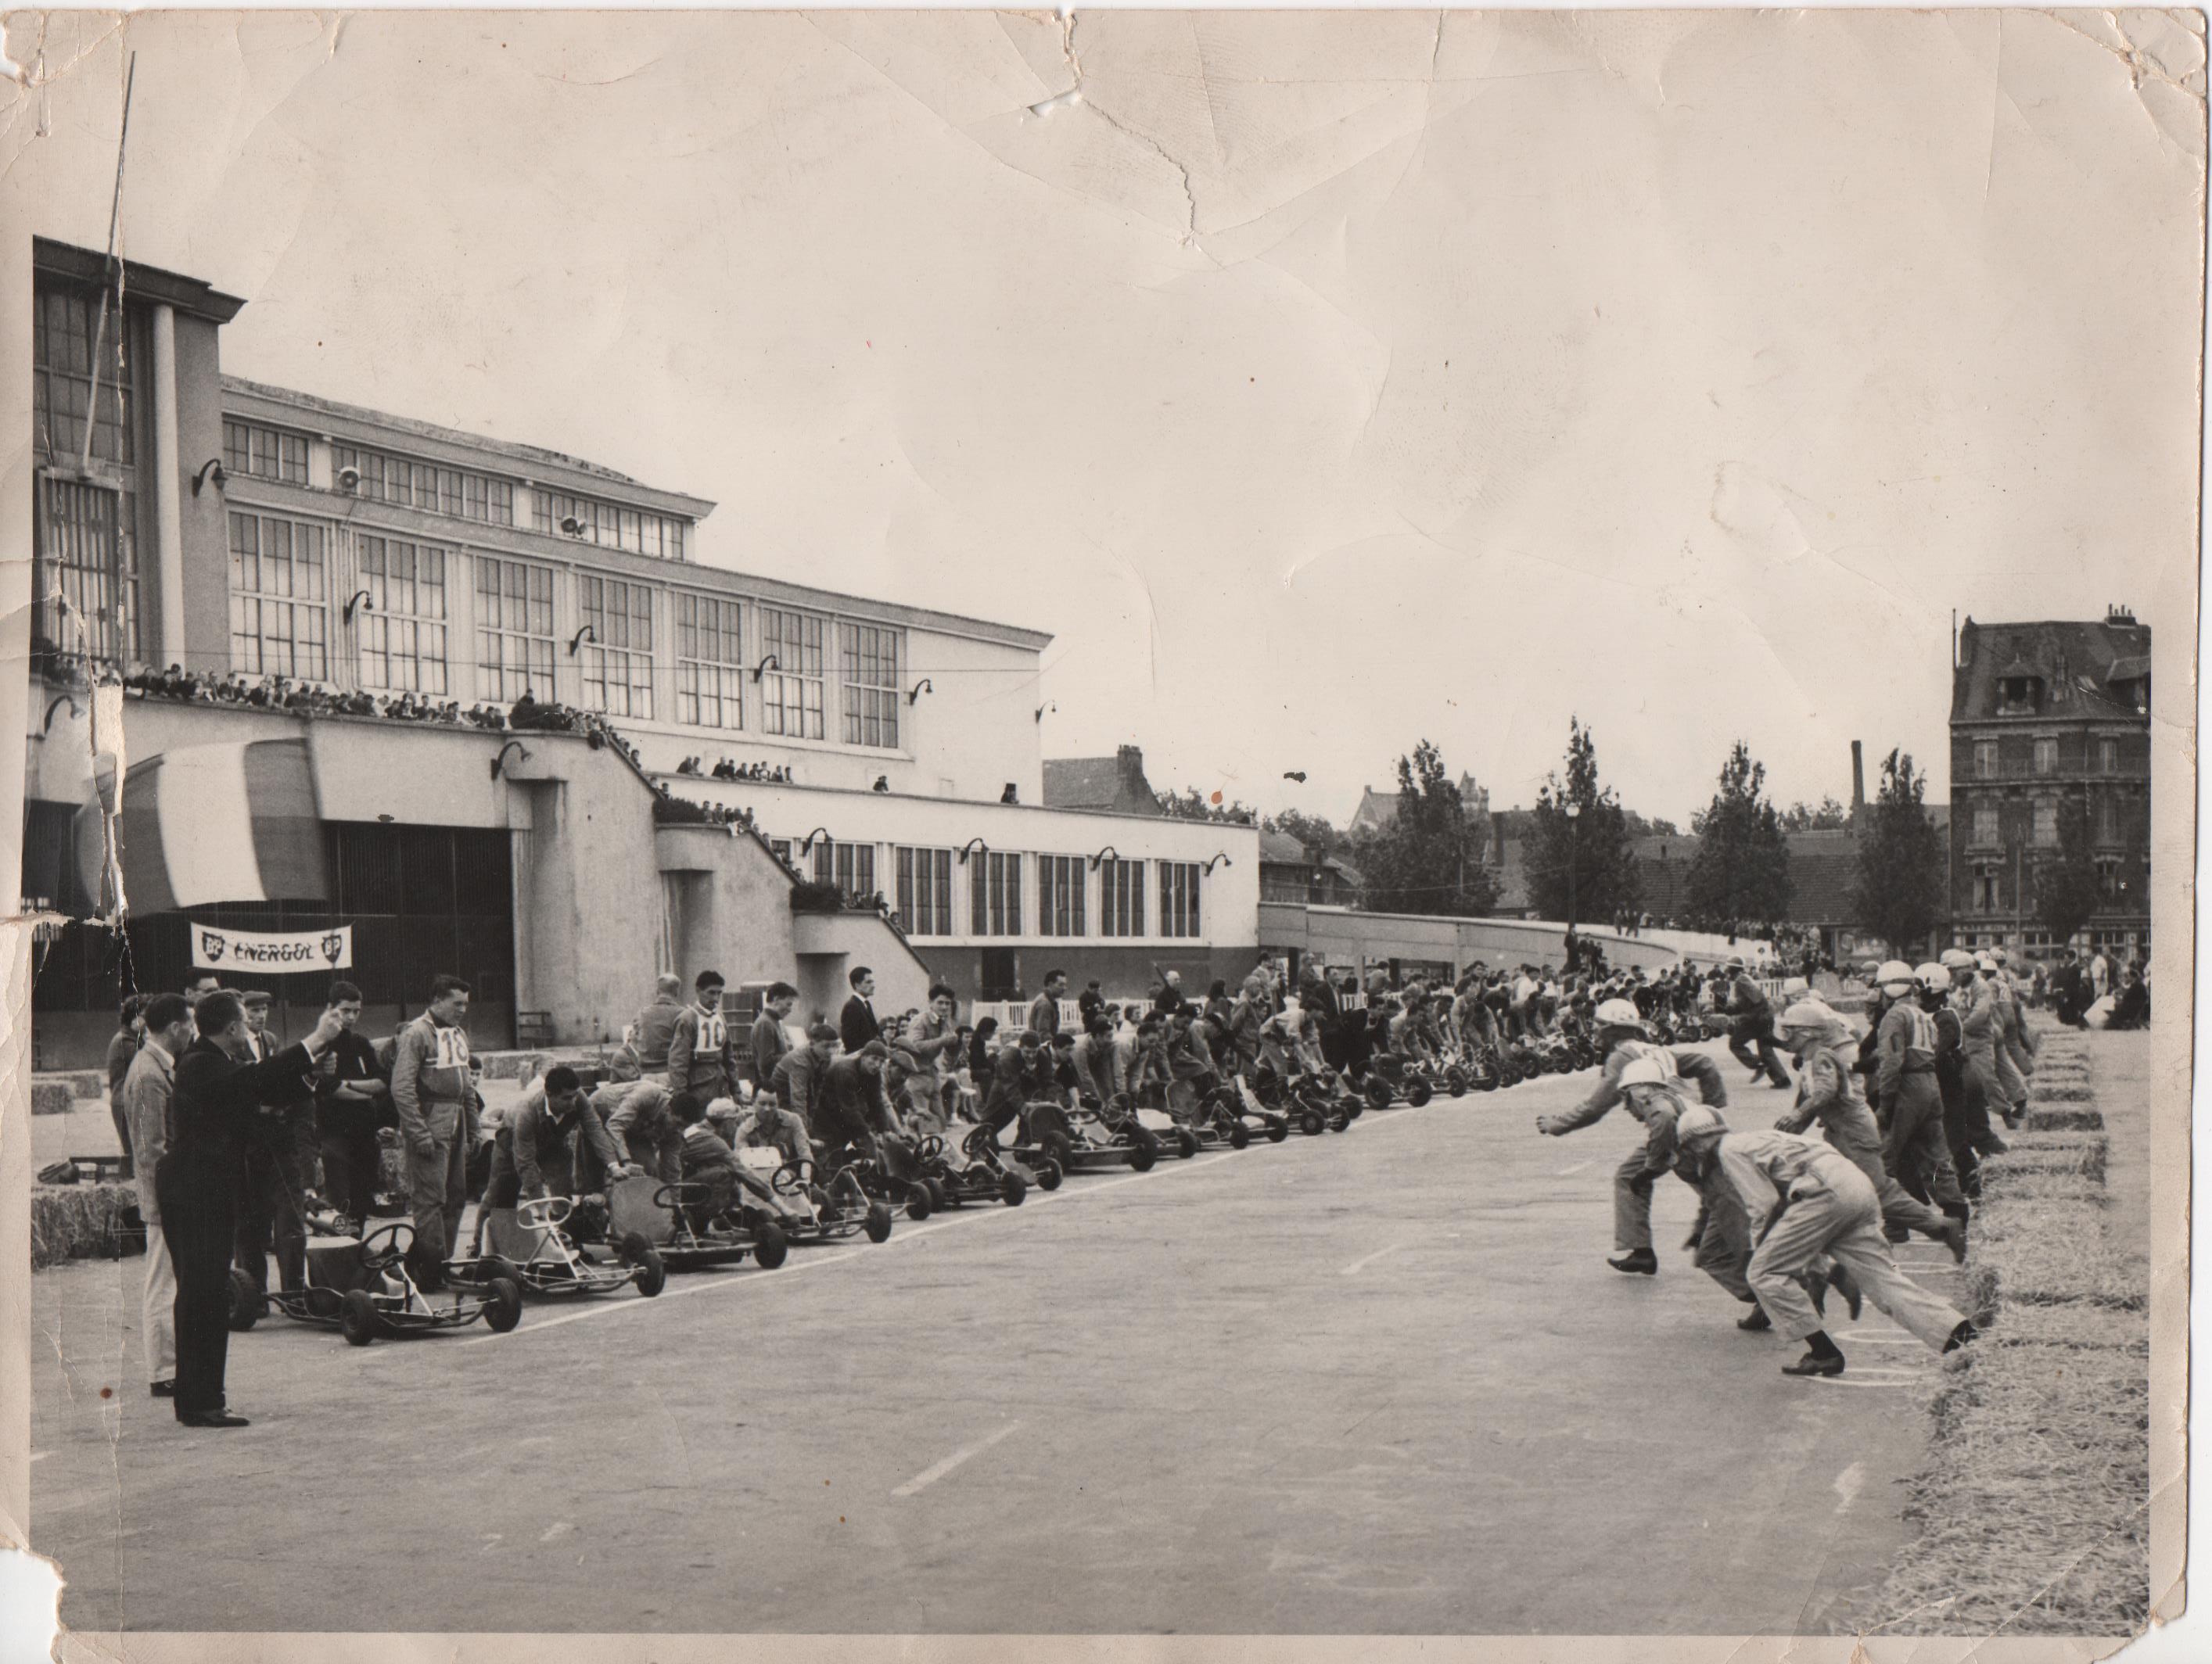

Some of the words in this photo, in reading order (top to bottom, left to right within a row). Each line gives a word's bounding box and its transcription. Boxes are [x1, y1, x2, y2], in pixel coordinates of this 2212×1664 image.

[203, 936, 223, 956] BP
[235, 943, 314, 962] ENERGOL
[323, 938, 341, 956] BP
[702, 1021, 726, 1049] 10
